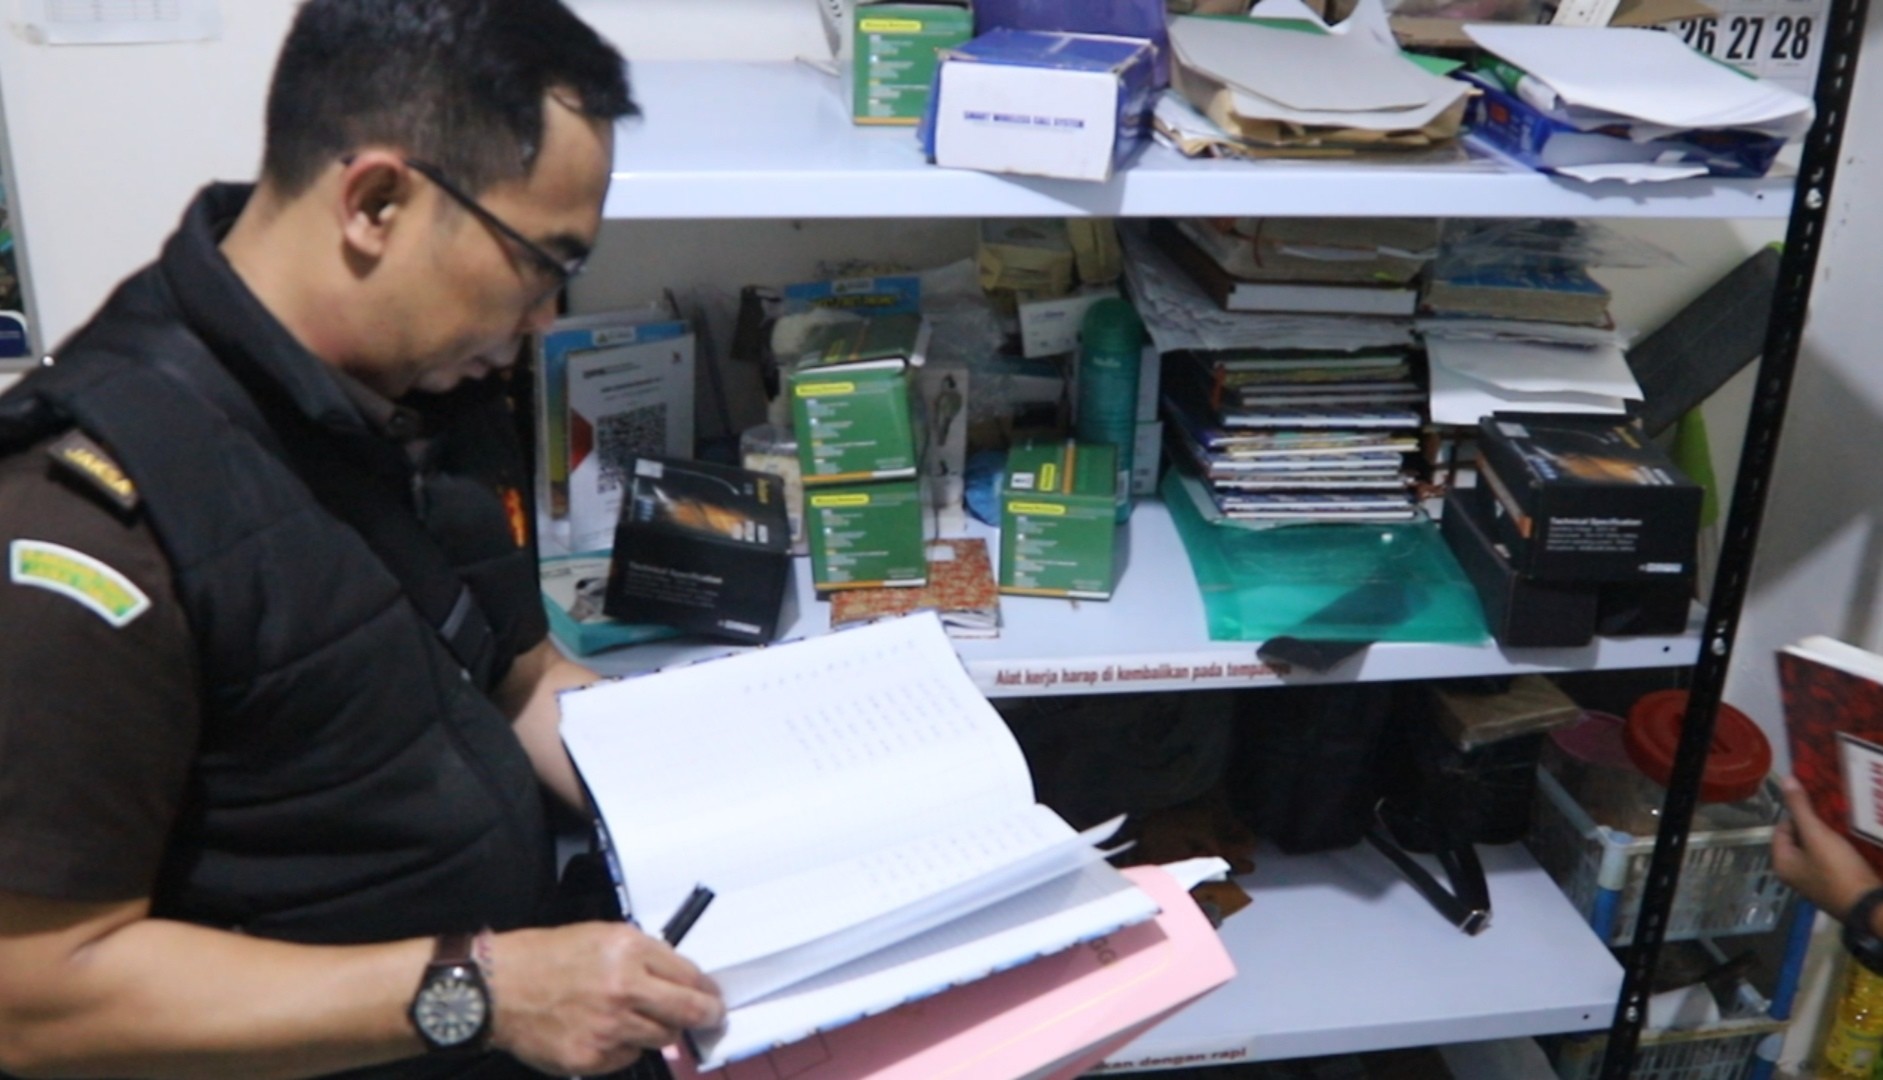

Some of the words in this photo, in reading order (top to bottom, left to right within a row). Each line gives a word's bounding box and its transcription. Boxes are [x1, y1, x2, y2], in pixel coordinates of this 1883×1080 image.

[1680, 18, 1718, 56] 26
[1726, 16, 1765, 60] 27
[1770, 16, 1812, 60] 28
[1025, 667, 1057, 688] kerja
[1061, 666, 1098, 686] harap
[1101, 665, 1113, 682] di
[1192, 661, 1222, 682] pada
[1139, 1053, 1207, 1066] dengan
[1211, 1047, 1248, 1060] rapi
